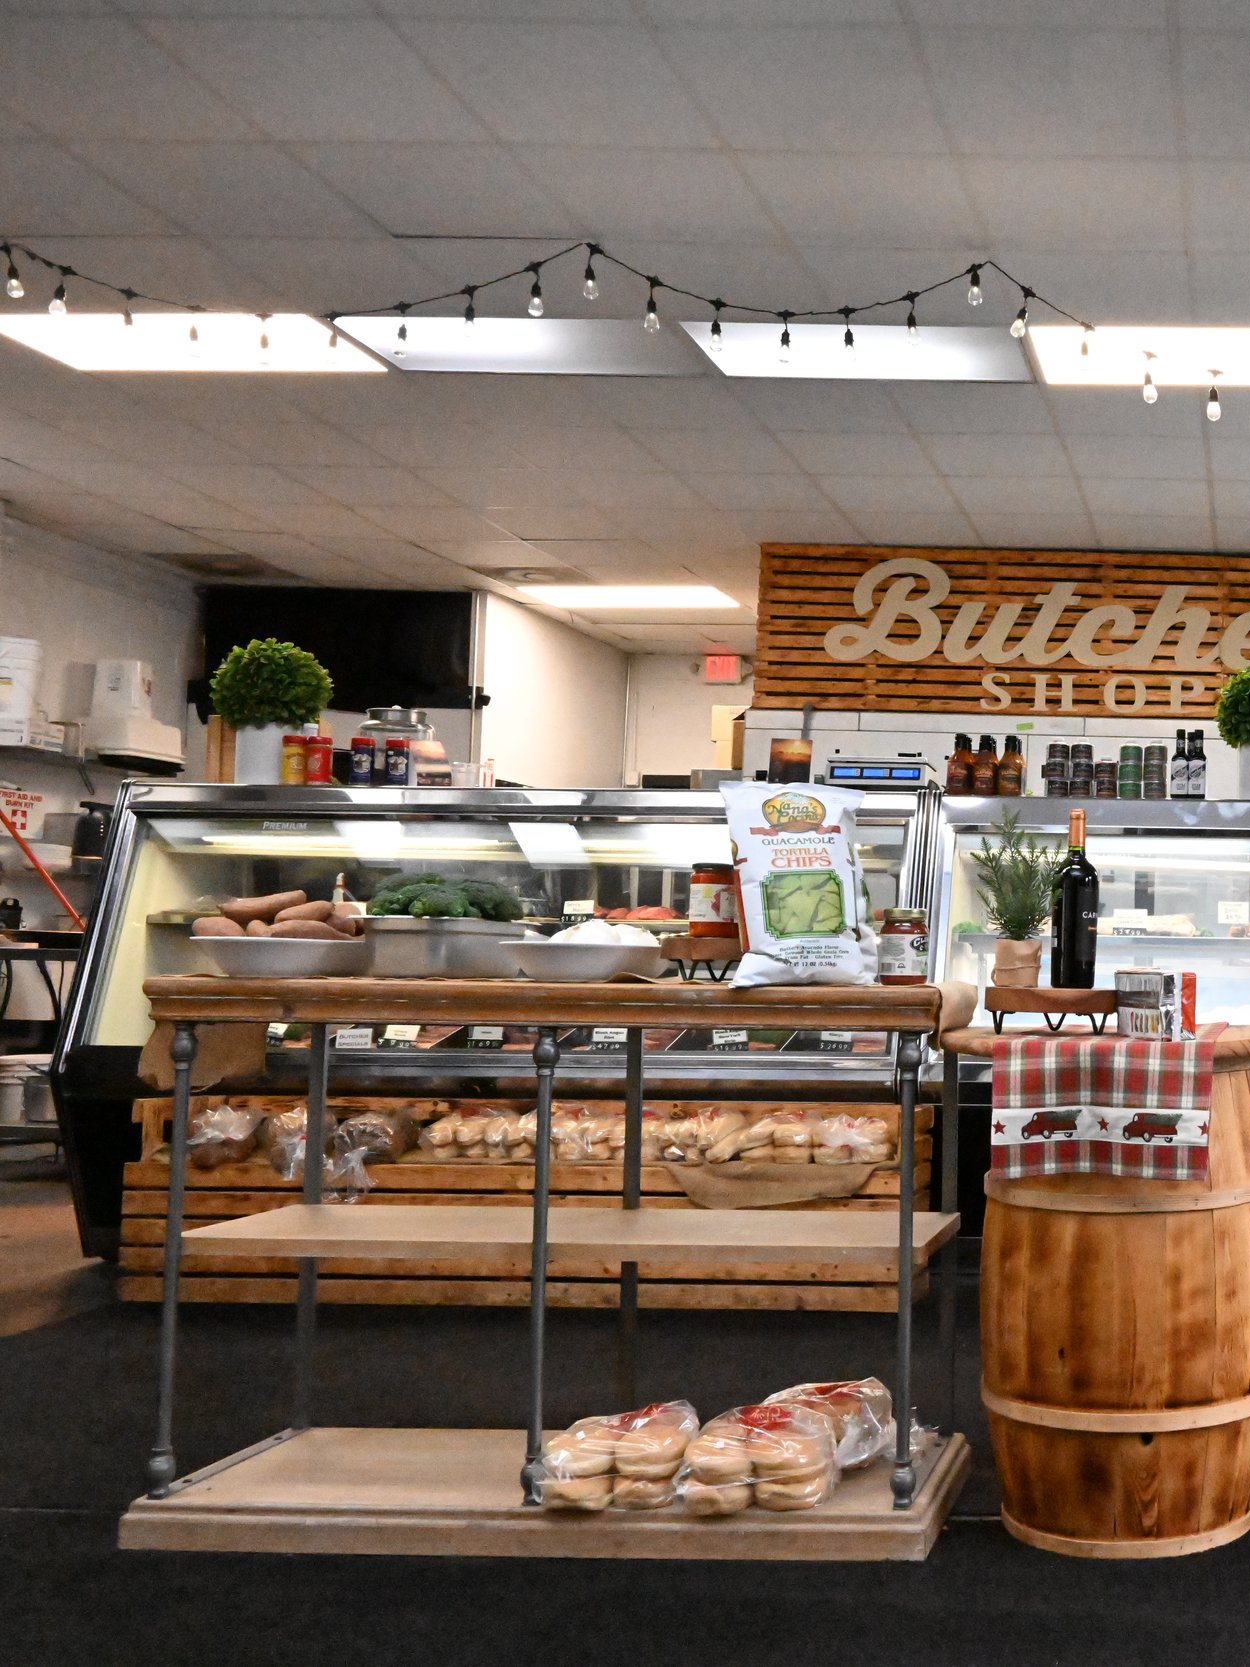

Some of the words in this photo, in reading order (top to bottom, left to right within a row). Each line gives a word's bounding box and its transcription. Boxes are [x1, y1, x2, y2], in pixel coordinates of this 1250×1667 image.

[979, 672, 1206, 715] SHOP
[262, 821, 308, 830] PREMIUM
[771, 847, 829, 857] TORTILLA
[770, 855, 832, 869] CHIPS
